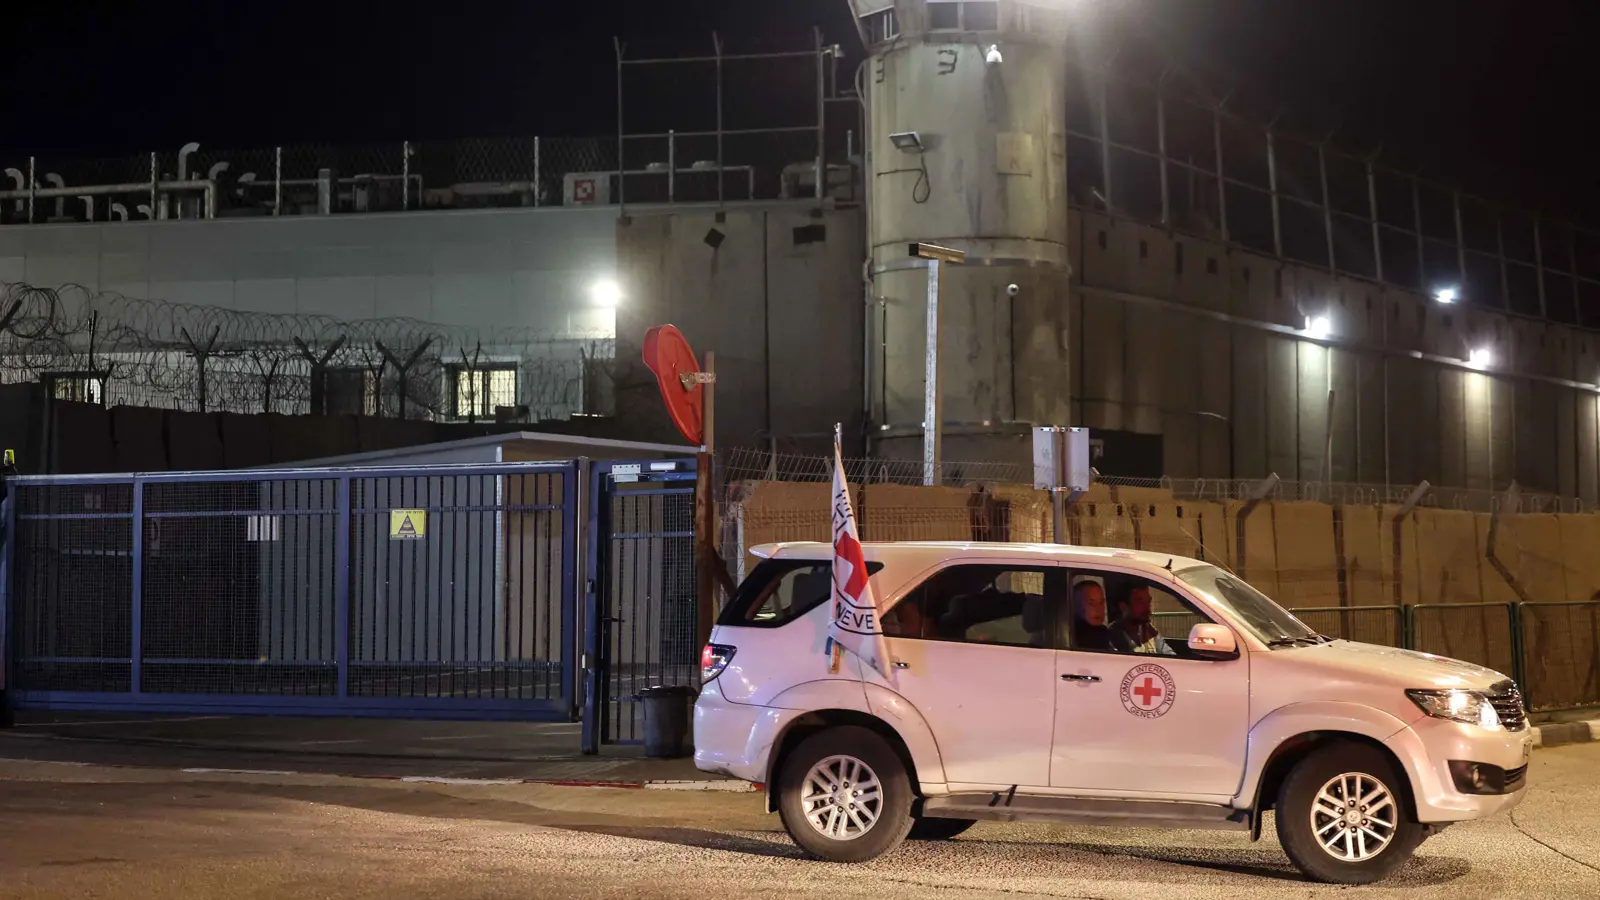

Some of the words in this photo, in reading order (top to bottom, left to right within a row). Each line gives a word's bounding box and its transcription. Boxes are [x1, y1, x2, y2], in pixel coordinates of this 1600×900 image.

[1122, 671, 1135, 703] COMITE
[1135, 665, 1174, 706] INTERNATIONAL
[1130, 706, 1162, 719] GENEVE
